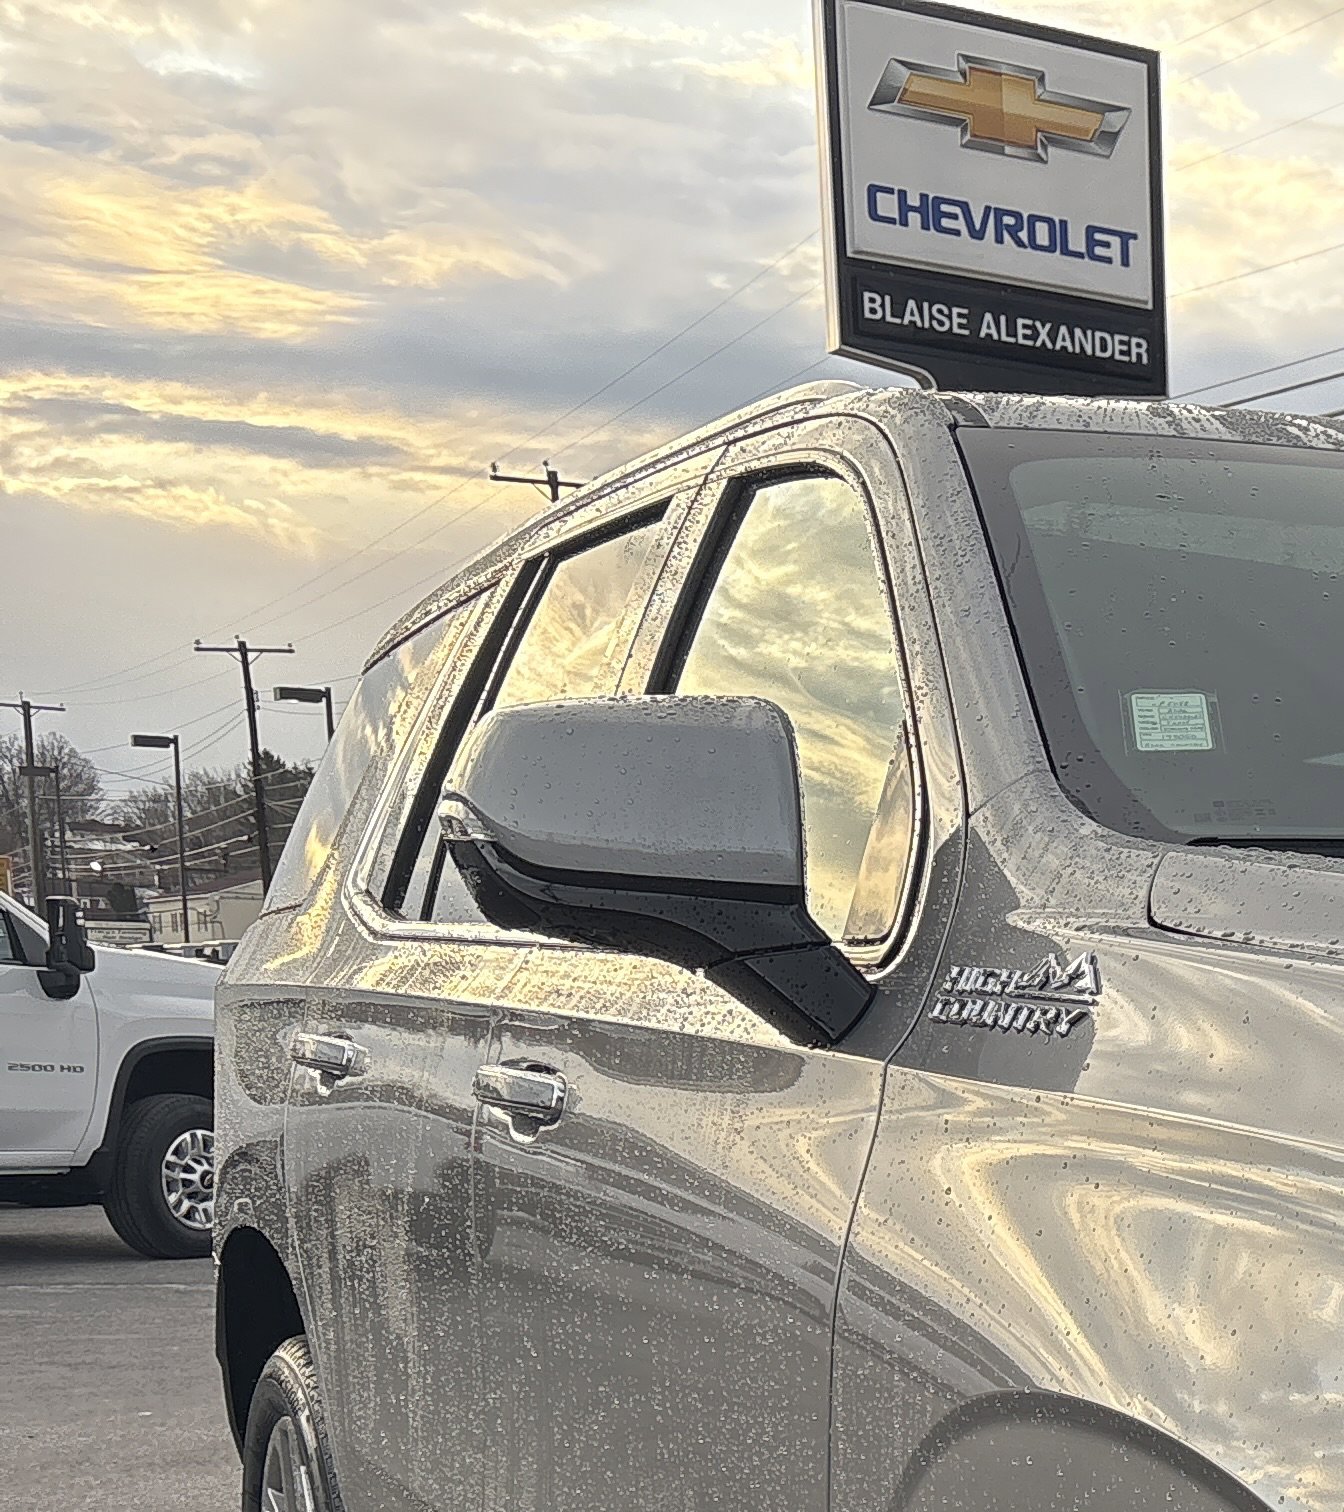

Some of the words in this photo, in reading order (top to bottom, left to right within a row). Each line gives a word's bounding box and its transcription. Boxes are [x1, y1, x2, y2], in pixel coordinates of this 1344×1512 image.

[866, 183, 1139, 268] CHEVROLET
[862, 291, 971, 336] BLAISE
[978, 312, 1149, 365] ALEXANDER
[7, 1062, 55, 1073] 2500
[59, 1064, 85, 1074] HD
